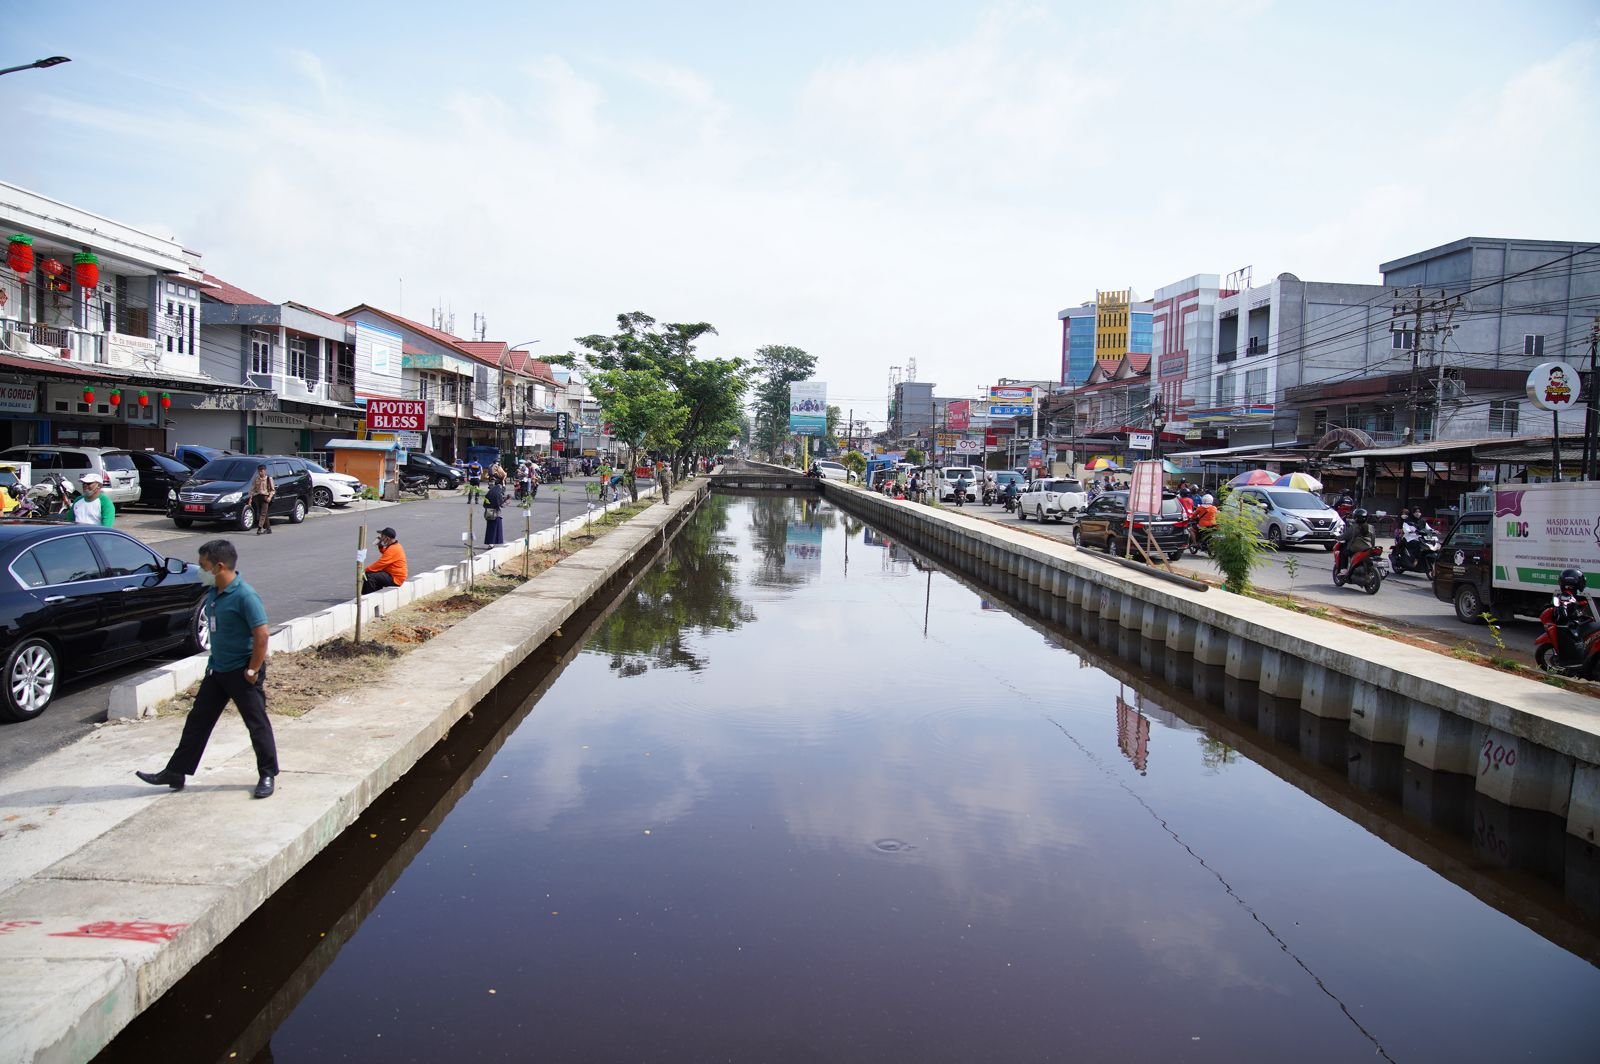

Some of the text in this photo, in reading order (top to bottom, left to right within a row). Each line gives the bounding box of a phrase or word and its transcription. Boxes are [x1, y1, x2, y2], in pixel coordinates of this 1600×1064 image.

[8, 388, 36, 400] GORDEN
[369, 401, 424, 415] APOTEK
[264, 415, 283, 424] APOTEK
[374, 415, 418, 429] BLESS
[1546, 518, 1591, 526] MASJID KAPAL
[1506, 521, 1529, 537] MDC
[1546, 527, 1591, 536] MUNZALAN
[1482, 740, 1516, 776] 300
